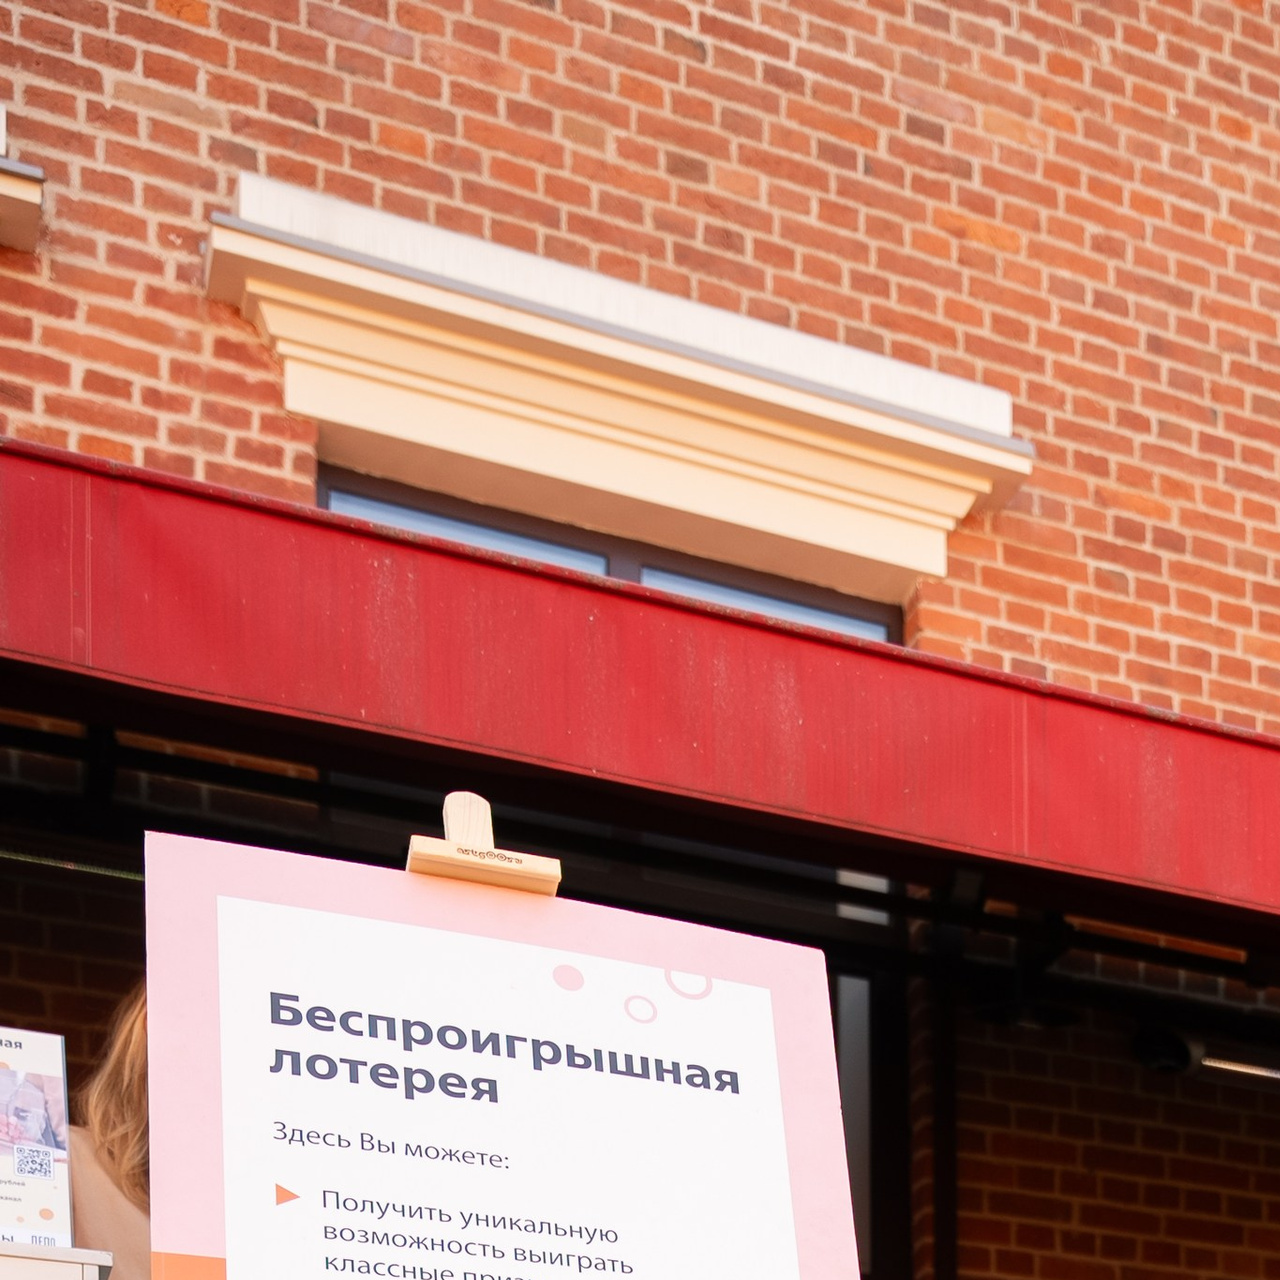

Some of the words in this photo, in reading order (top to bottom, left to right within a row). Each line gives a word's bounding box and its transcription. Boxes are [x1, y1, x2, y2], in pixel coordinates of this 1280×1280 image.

[269, 991, 741, 1095] Беспроигрышная
[269, 1048, 500, 1104] лотерея
[273, 1121, 352, 1149] Здесь
[360, 1132, 396, 1155] Вы
[404, 1143, 511, 1170] можете:
[322, 1189, 452, 1223] Получить
[459, 1211, 619, 1245] уникальную
[323, 1225, 506, 1259] возможность
[513, 1247, 634, 1275] выиграть
